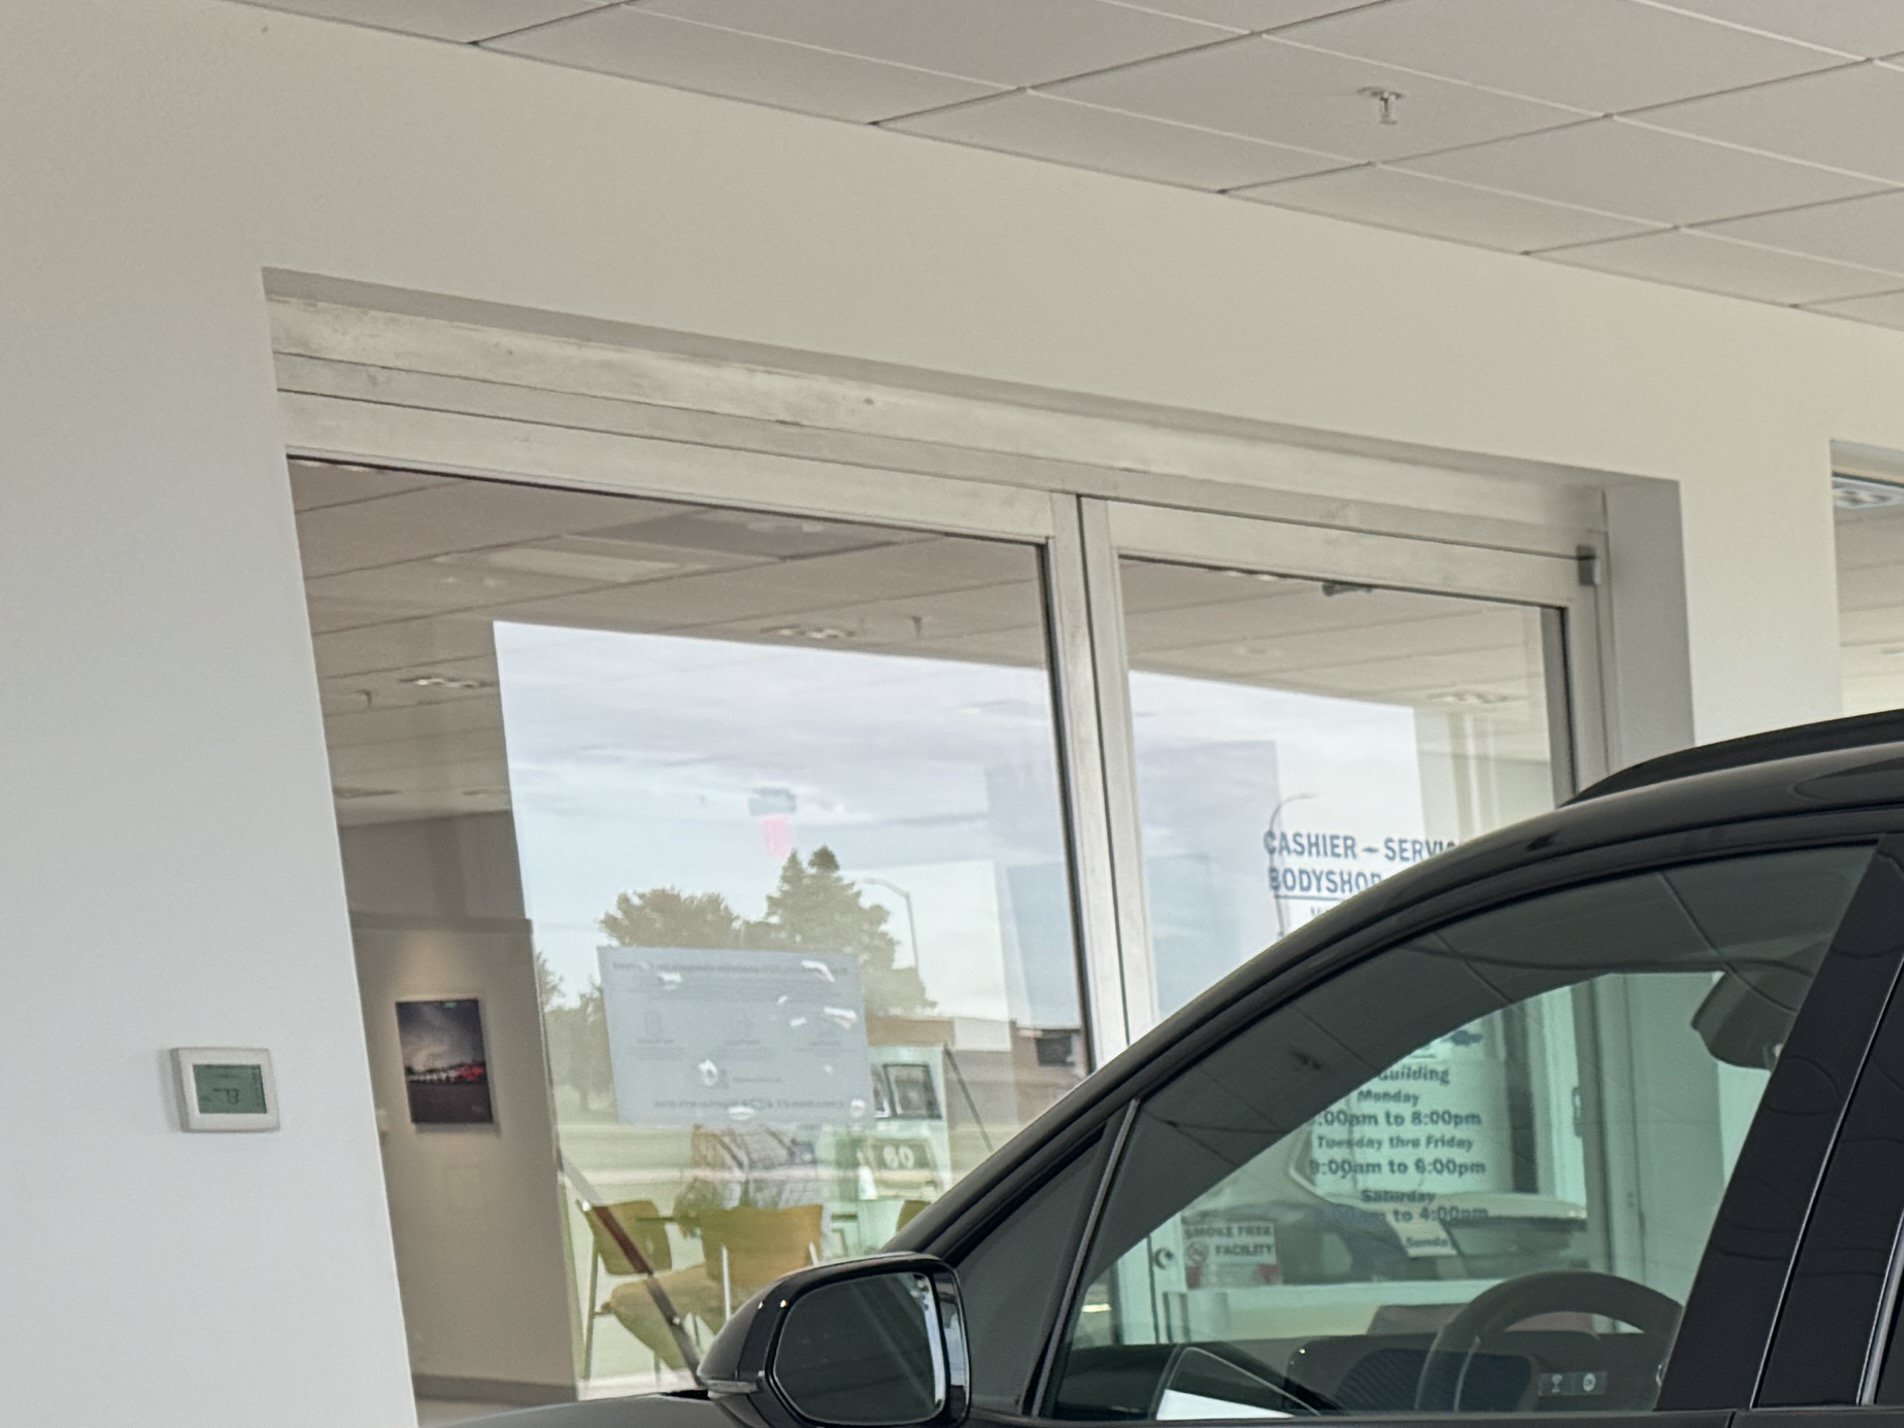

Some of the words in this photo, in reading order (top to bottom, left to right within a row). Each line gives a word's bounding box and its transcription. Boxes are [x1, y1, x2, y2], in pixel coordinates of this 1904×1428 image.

[1263, 830, 1357, 859] CASHIER
[1357, 1089, 1420, 1107] Monday
[1385, 1111, 1405, 1126] to
[1411, 1110, 1482, 1128] 8:00pm
[1389, 1136, 1421, 1150] thru
[1425, 1136, 1474, 1151] Friday
[1388, 1159, 1409, 1175] to
[1361, 1189, 1437, 1204] Saturday
[1393, 1209, 1414, 1223] to
